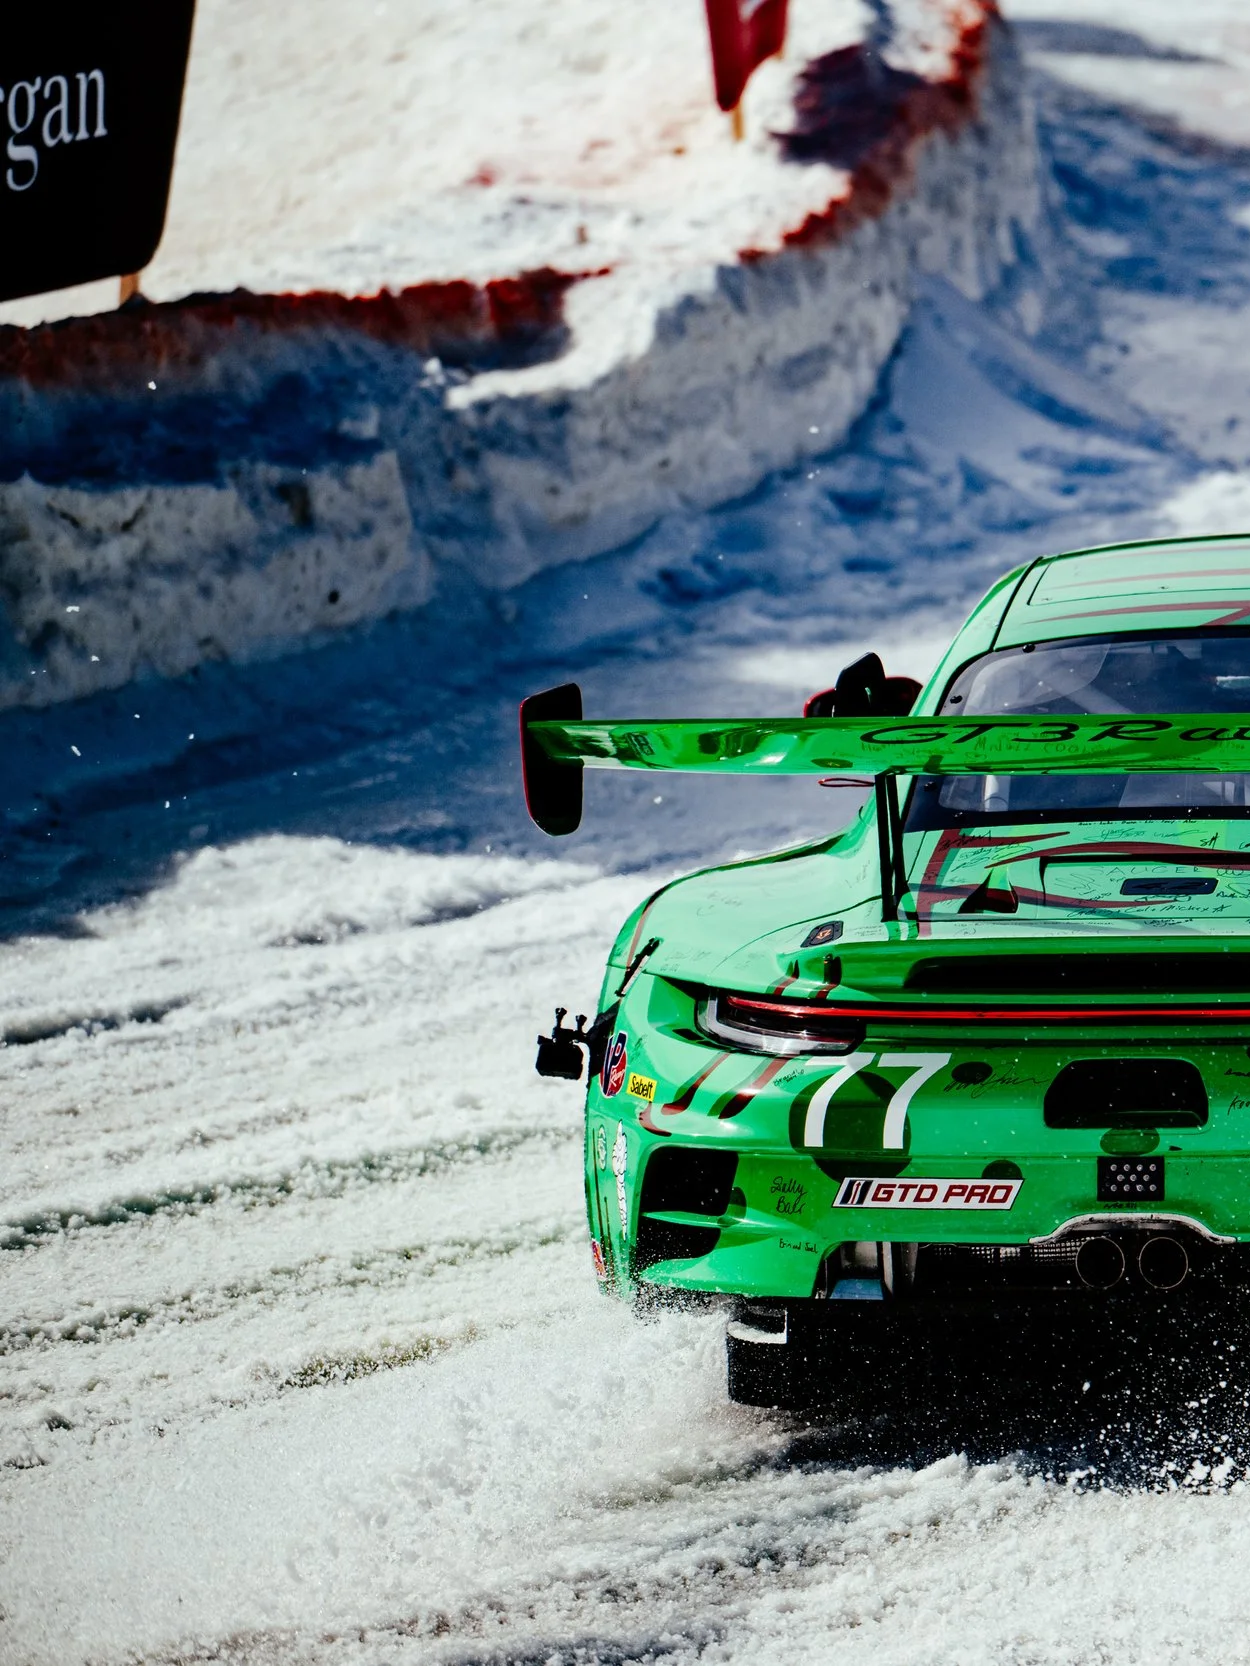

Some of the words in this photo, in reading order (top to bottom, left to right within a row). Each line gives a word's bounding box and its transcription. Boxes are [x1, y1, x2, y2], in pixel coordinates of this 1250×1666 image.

[0, 68, 108, 191] gan
[630, 1075, 653, 1099] Sabelt
[803, 1052, 953, 1150] 77
[871, 1183, 939, 1203] GTD
[942, 1184, 1014, 1204] PRO
